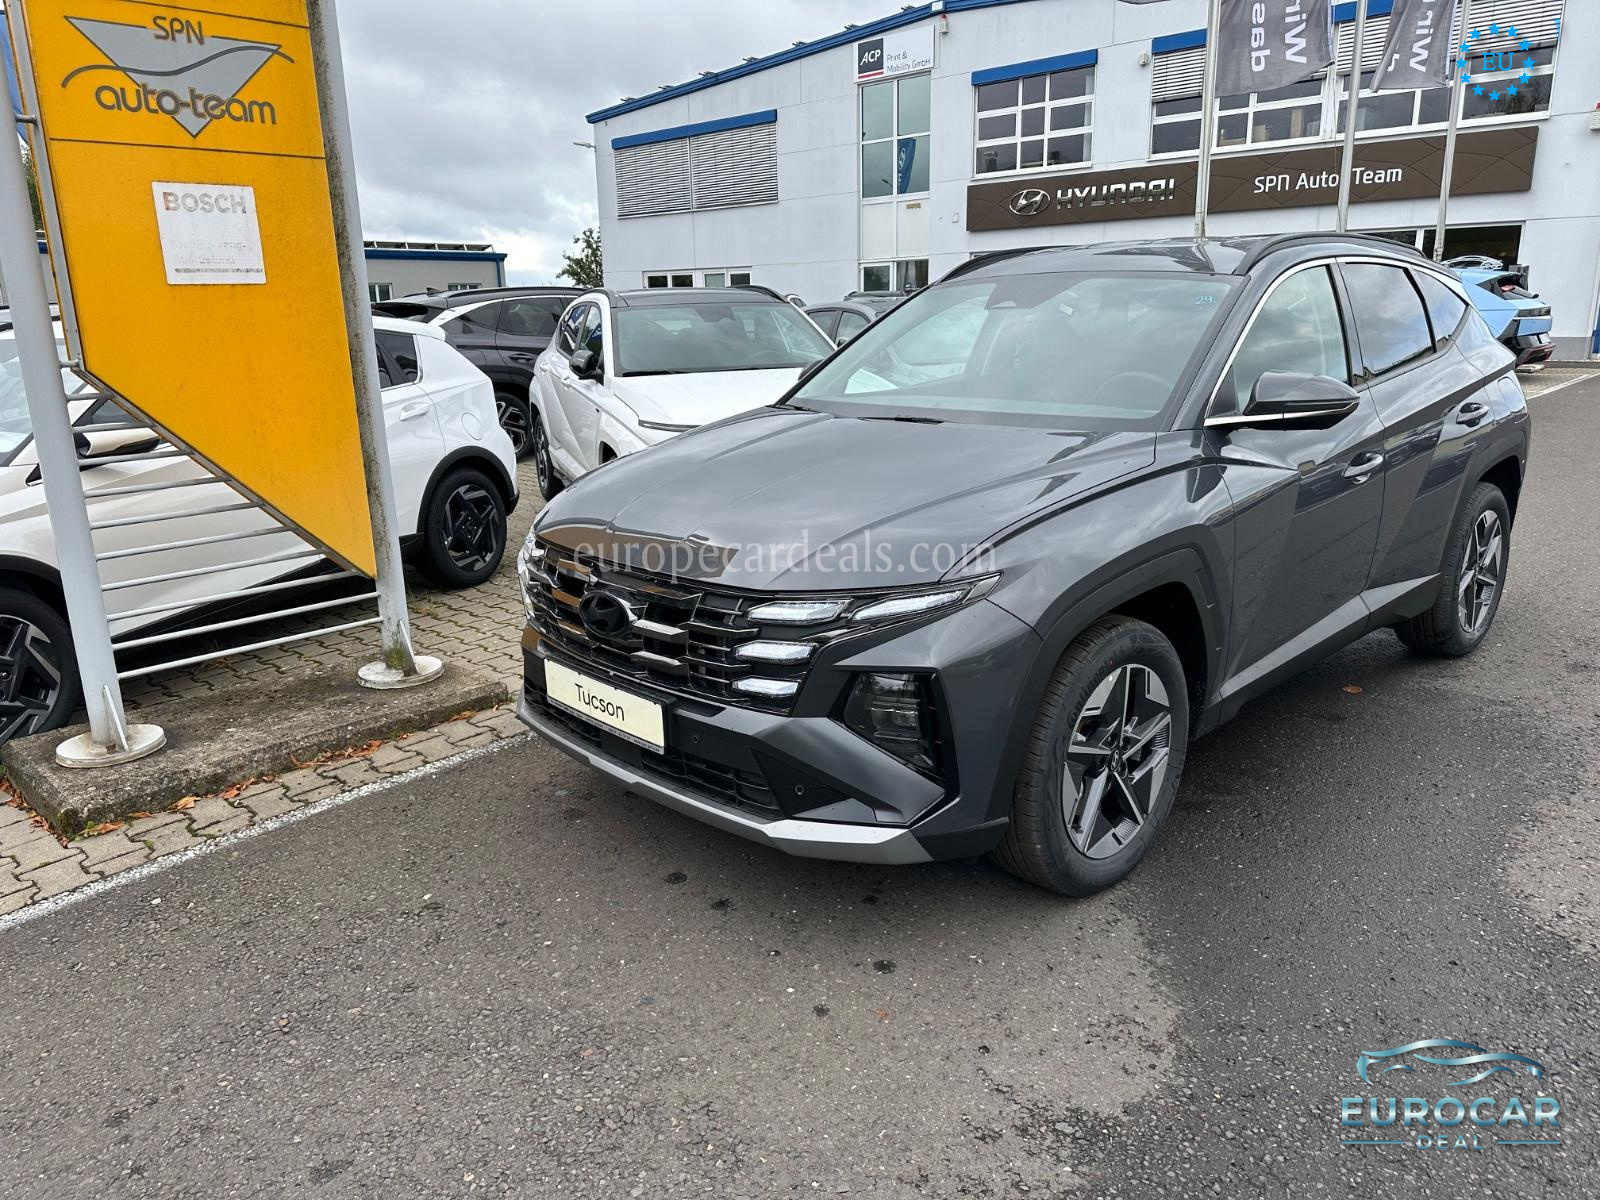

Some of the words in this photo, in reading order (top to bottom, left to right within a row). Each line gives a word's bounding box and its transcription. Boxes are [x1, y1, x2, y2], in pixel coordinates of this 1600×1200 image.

[152, 16, 205, 45] SPN
[860, 49, 881, 66] ACP
[886, 53, 901, 62] Print
[912, 58, 931, 68] GmbH
[95, 82, 277, 125] auto-team
[1056, 178, 1175, 210] HYUNDAI
[1253, 174, 1290, 194] SPN
[1295, 172, 1339, 190] Auto
[1351, 167, 1403, 185] Team
[162, 191, 247, 214] BOSCH
[575, 683, 625, 721] Tucson
